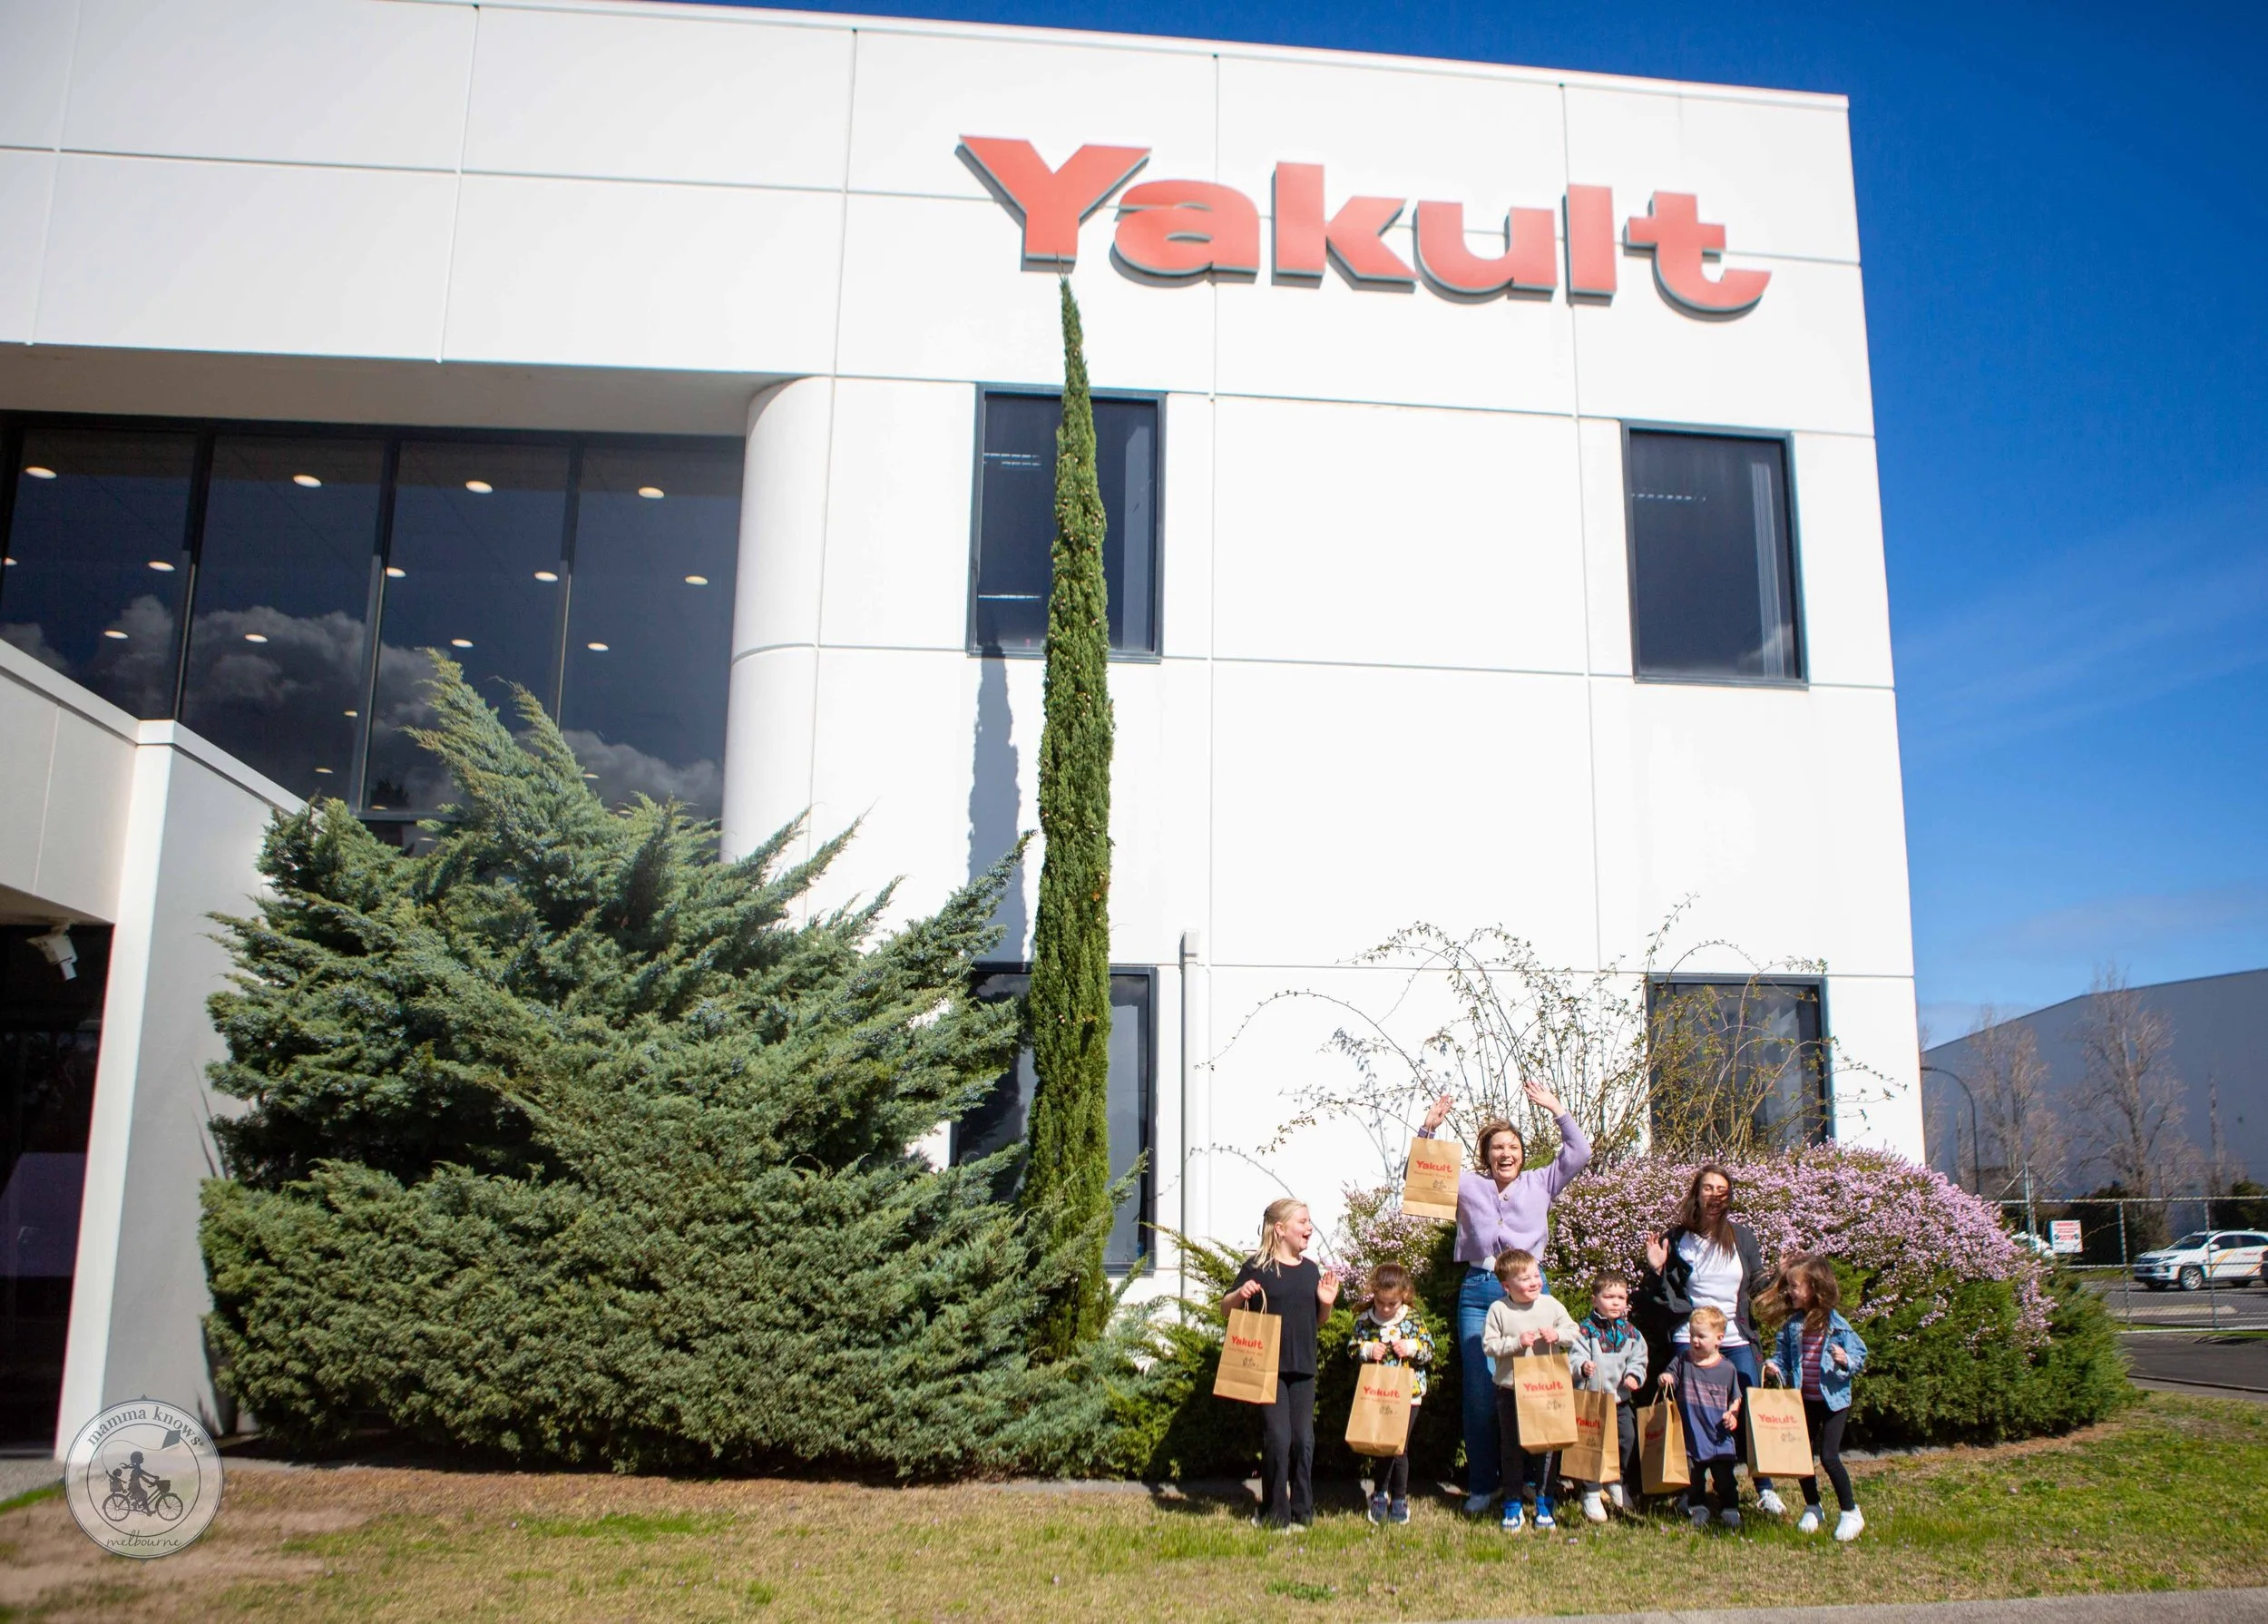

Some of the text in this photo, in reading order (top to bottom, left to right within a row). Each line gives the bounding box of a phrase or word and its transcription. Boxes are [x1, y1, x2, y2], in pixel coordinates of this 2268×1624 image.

[956, 133, 1772, 319] Yakult
[1416, 1160, 1453, 1173] Yakult
[1231, 1335, 1264, 1350] Yakult
[1363, 1385, 1402, 1398] Yakult
[1524, 1380, 1563, 1392] Yakult
[1758, 1414, 1797, 1424] Yakult
